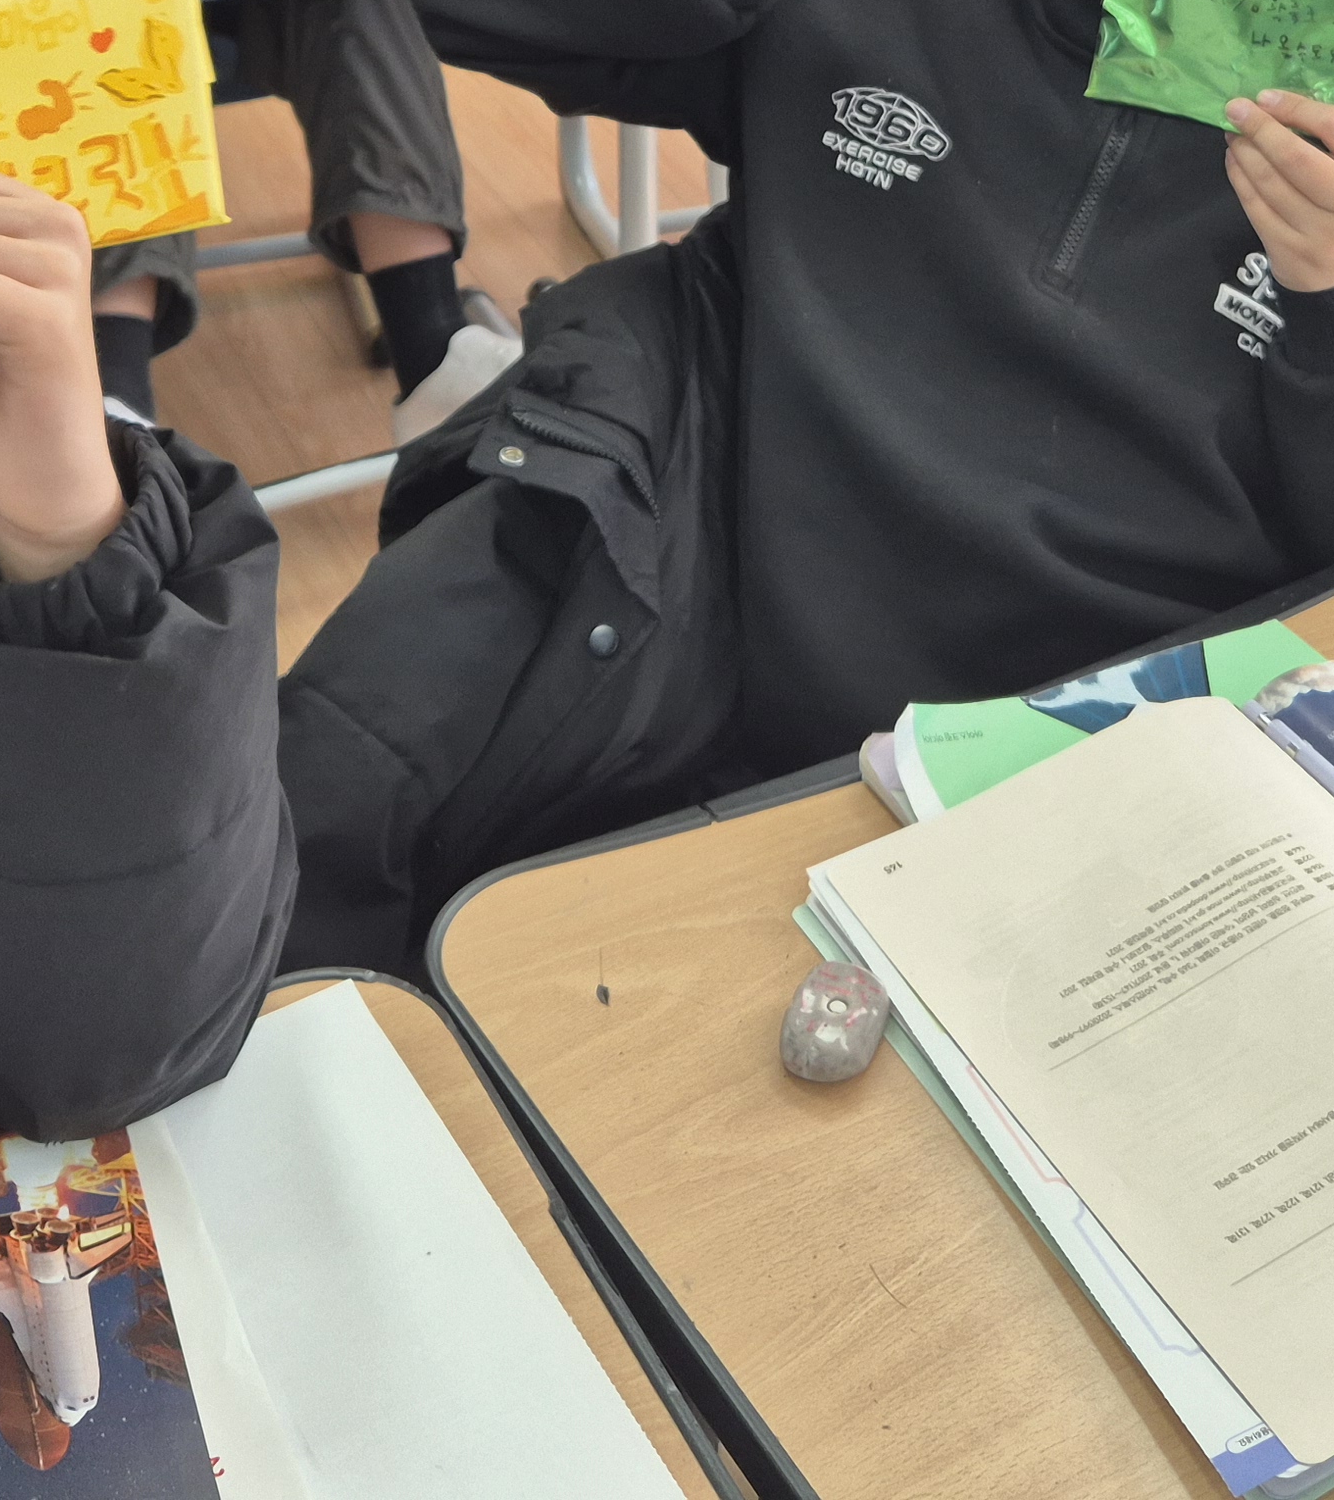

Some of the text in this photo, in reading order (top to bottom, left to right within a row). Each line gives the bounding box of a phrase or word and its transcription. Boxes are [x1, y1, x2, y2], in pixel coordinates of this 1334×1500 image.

[1106, 944, 1124, 957] 2021
[1129, 959, 1148, 973] 2021
[1059, 984, 1078, 998] 2021
